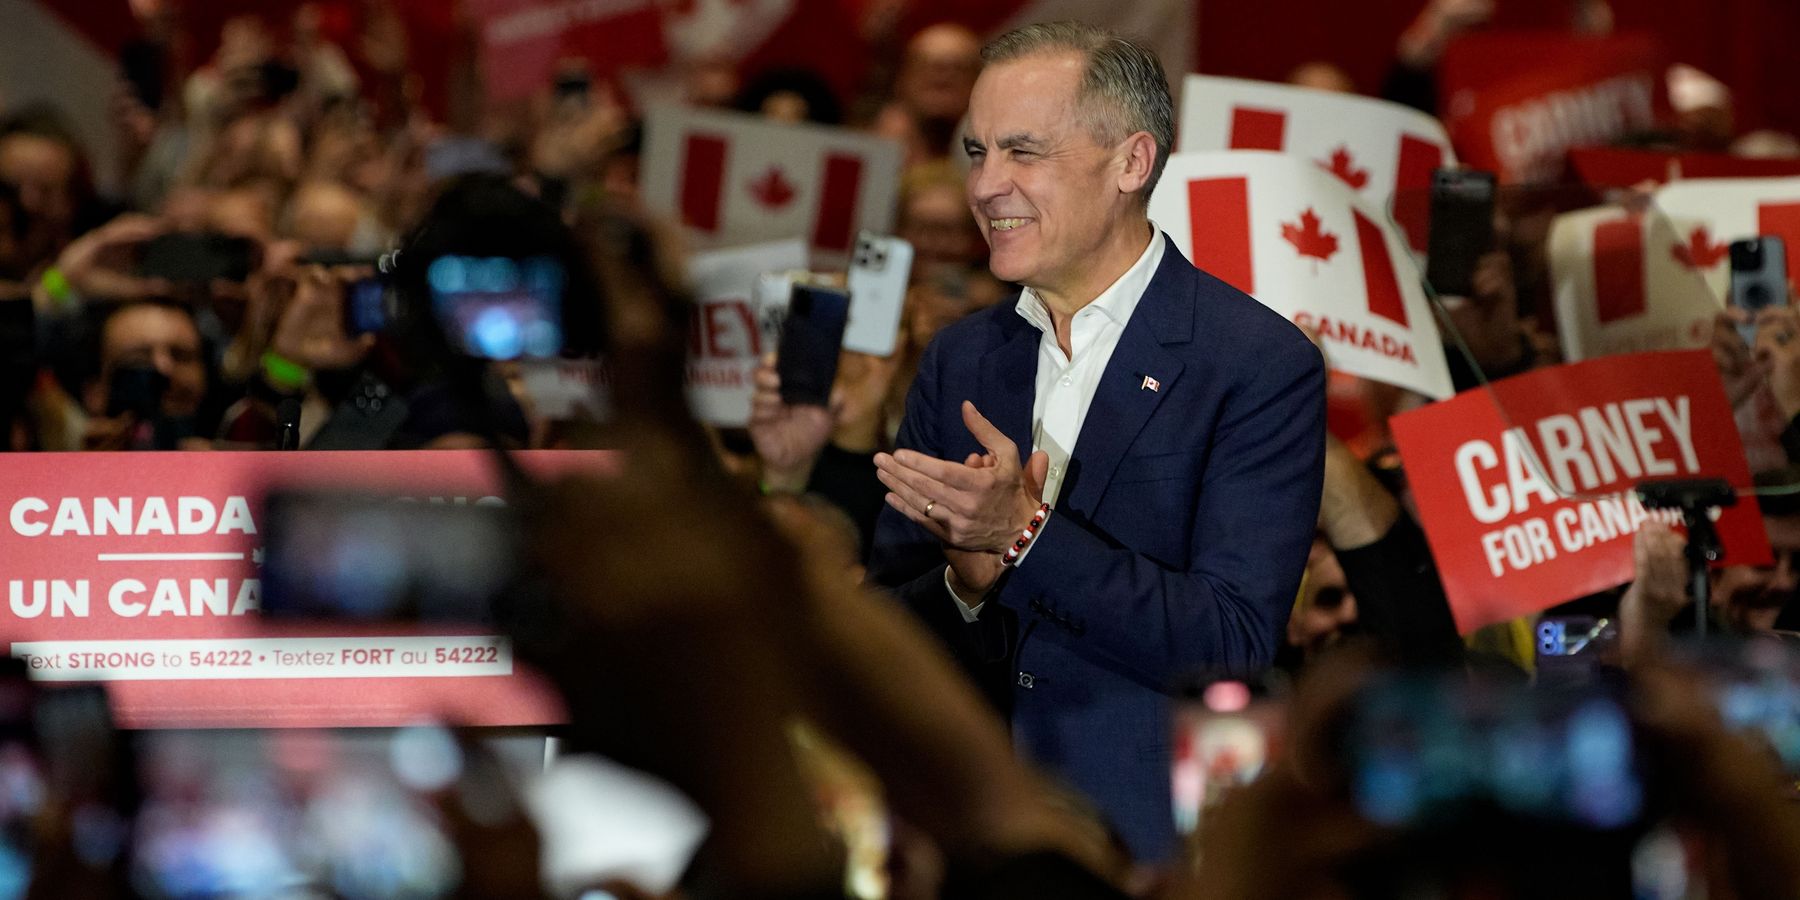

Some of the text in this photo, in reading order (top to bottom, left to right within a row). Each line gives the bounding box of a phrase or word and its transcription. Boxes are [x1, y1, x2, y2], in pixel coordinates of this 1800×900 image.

[1293, 310, 1418, 366] CANADA
[1454, 396, 1701, 524] CARNEY
[9, 496, 258, 537] CANADA
[1481, 487, 1687, 578] FOR CANA
[9, 578, 263, 618] UN CANA
[21, 646, 498, 669] Text STRONG to 54222 Textez FORT au 54222
